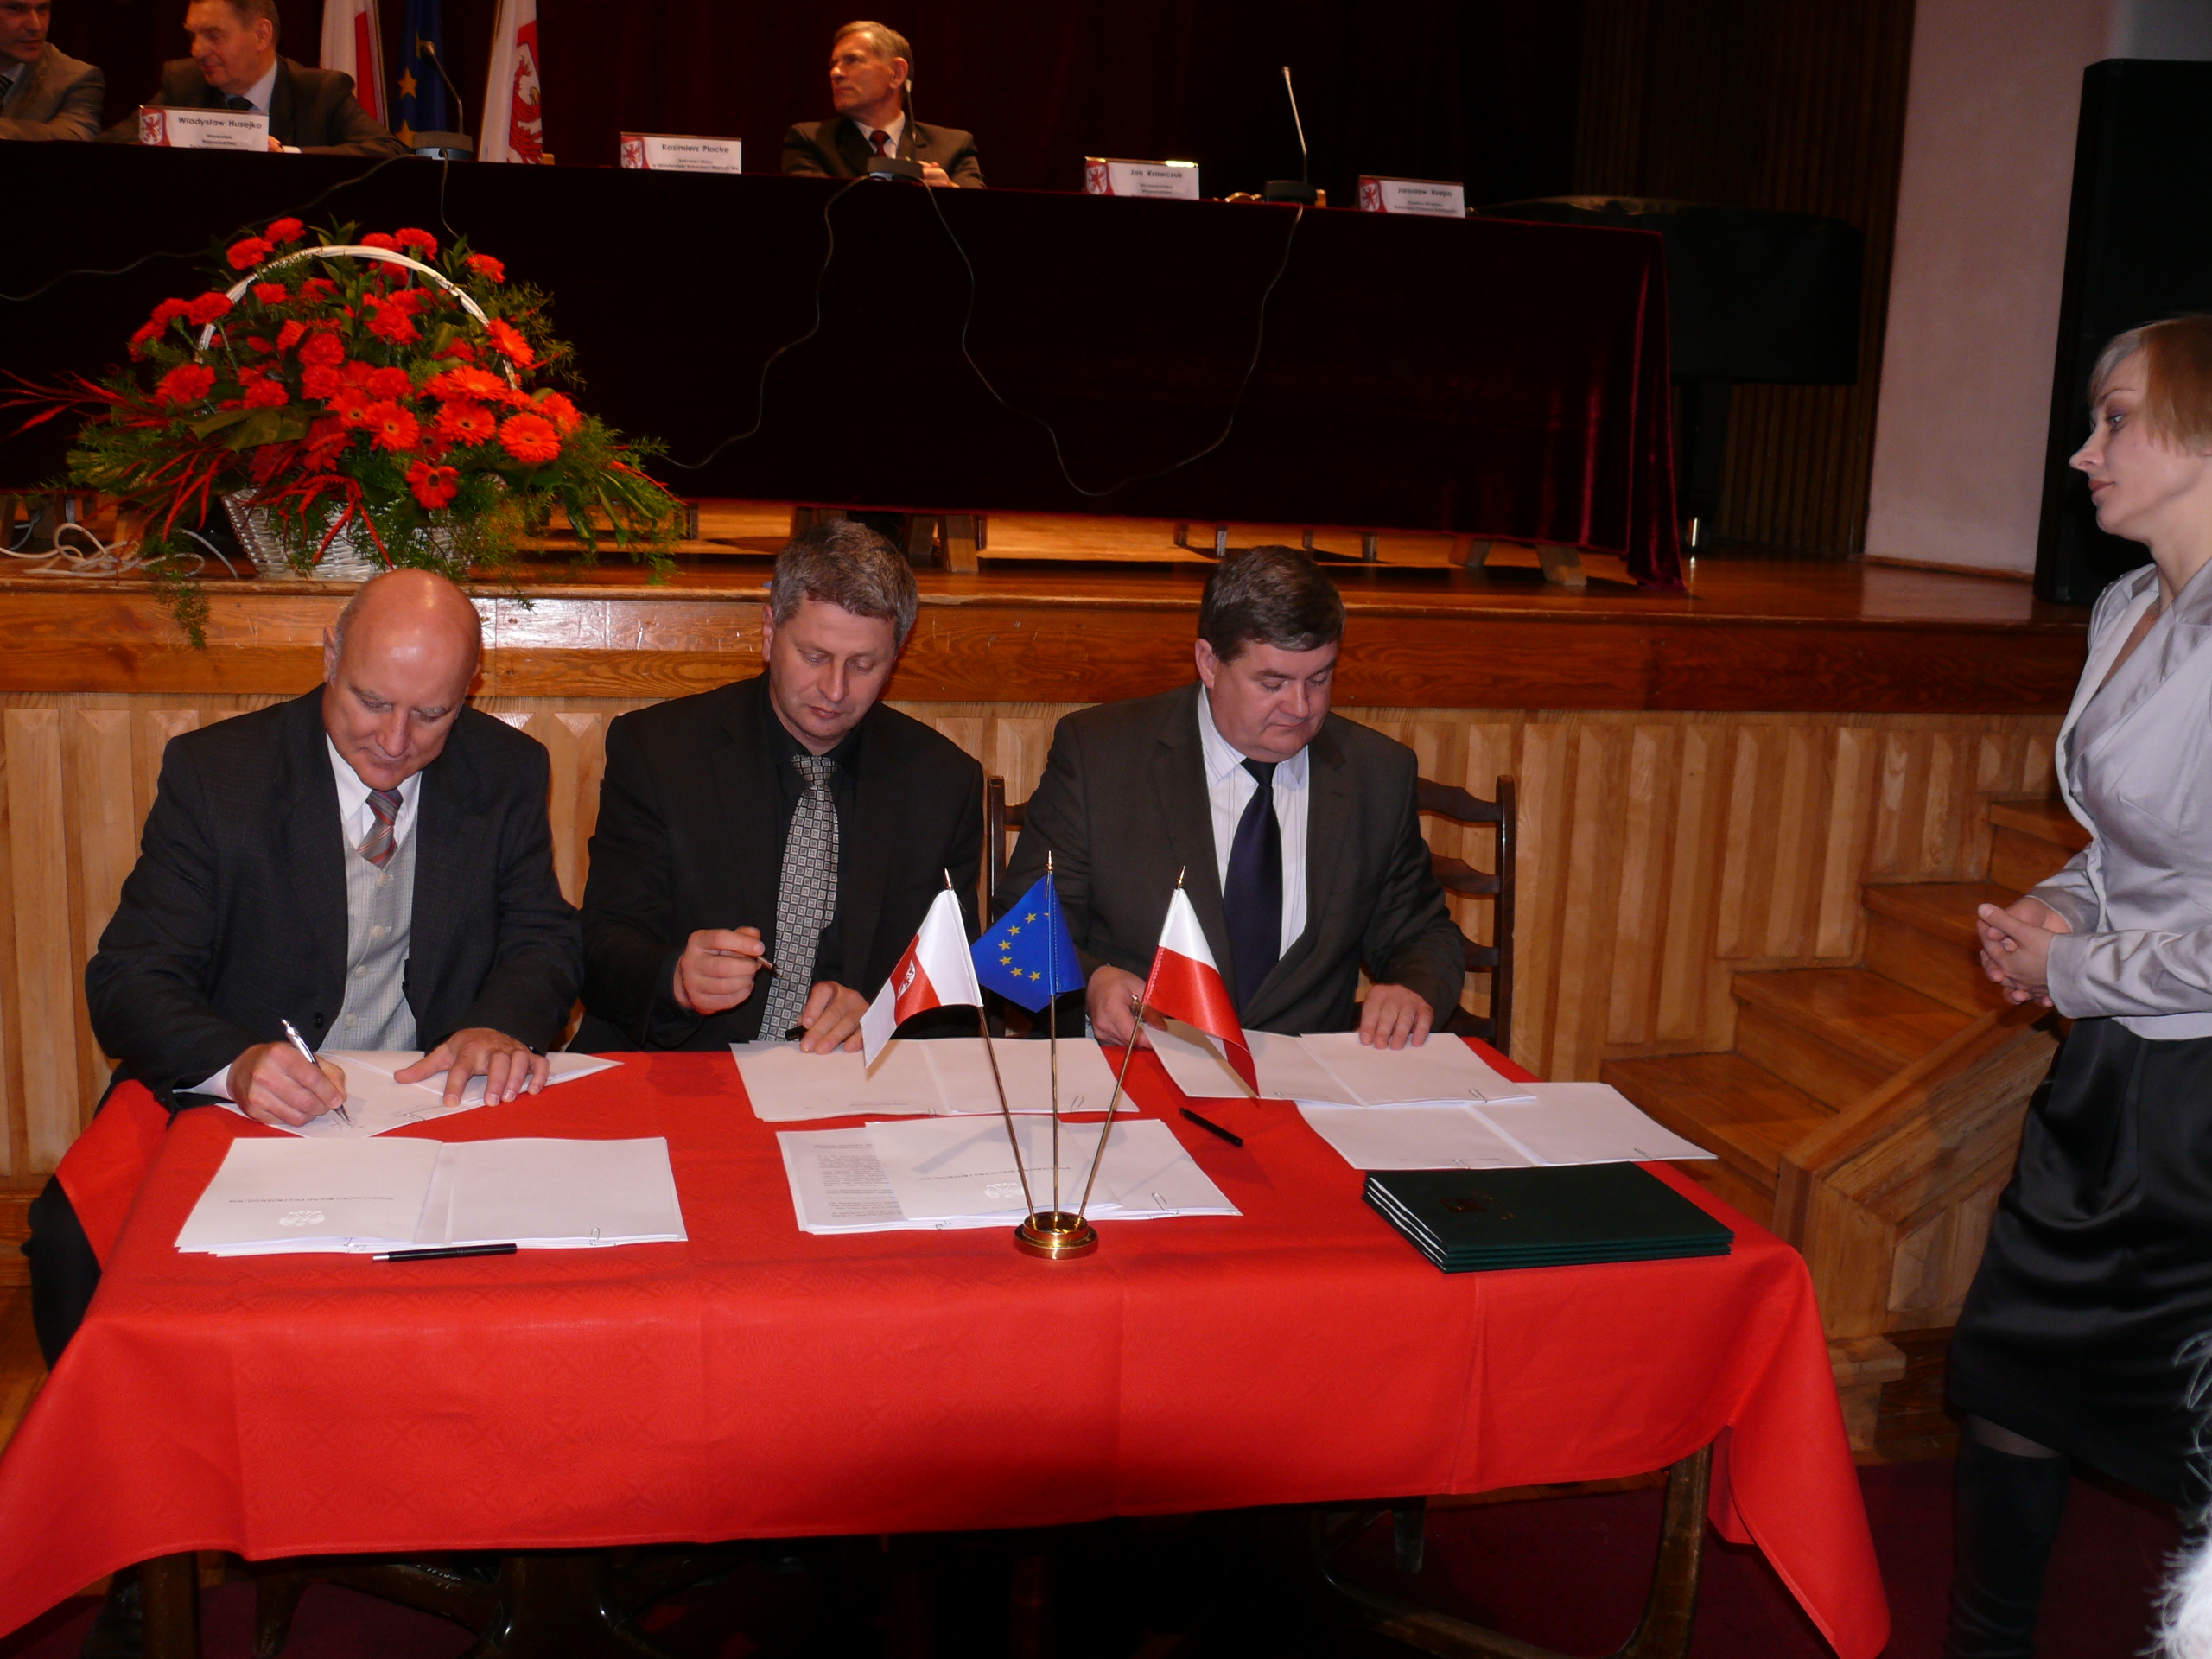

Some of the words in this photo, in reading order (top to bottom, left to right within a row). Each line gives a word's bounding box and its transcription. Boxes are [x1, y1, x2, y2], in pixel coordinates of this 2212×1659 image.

[228, 120, 262, 130] Husejko
[661, 143, 699, 152] Kazimierz
[1147, 169, 1183, 178] Krawczuk
